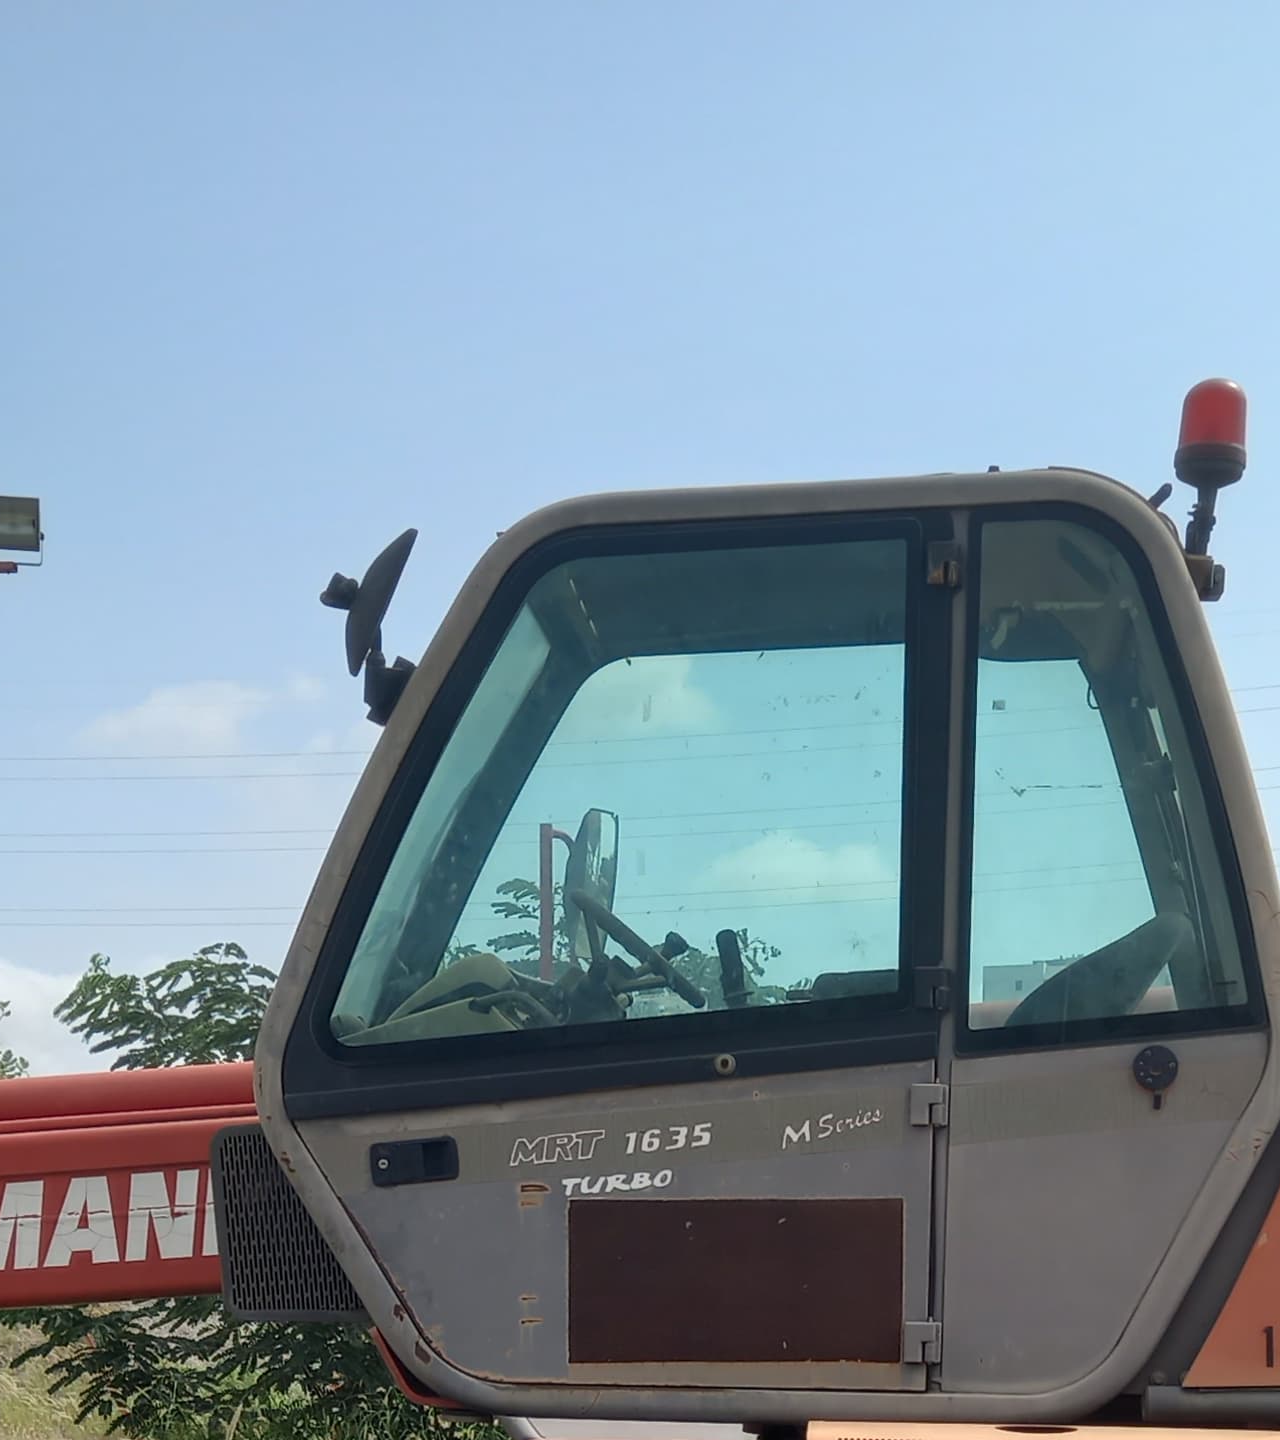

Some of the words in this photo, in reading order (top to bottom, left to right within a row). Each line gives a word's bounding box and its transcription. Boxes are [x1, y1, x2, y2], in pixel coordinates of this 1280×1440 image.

[509, 1129, 606, 1166] MRT
[625, 1122, 712, 1155] 1635
[782, 1120, 811, 1149] M
[561, 1169, 673, 1197] TURBO
